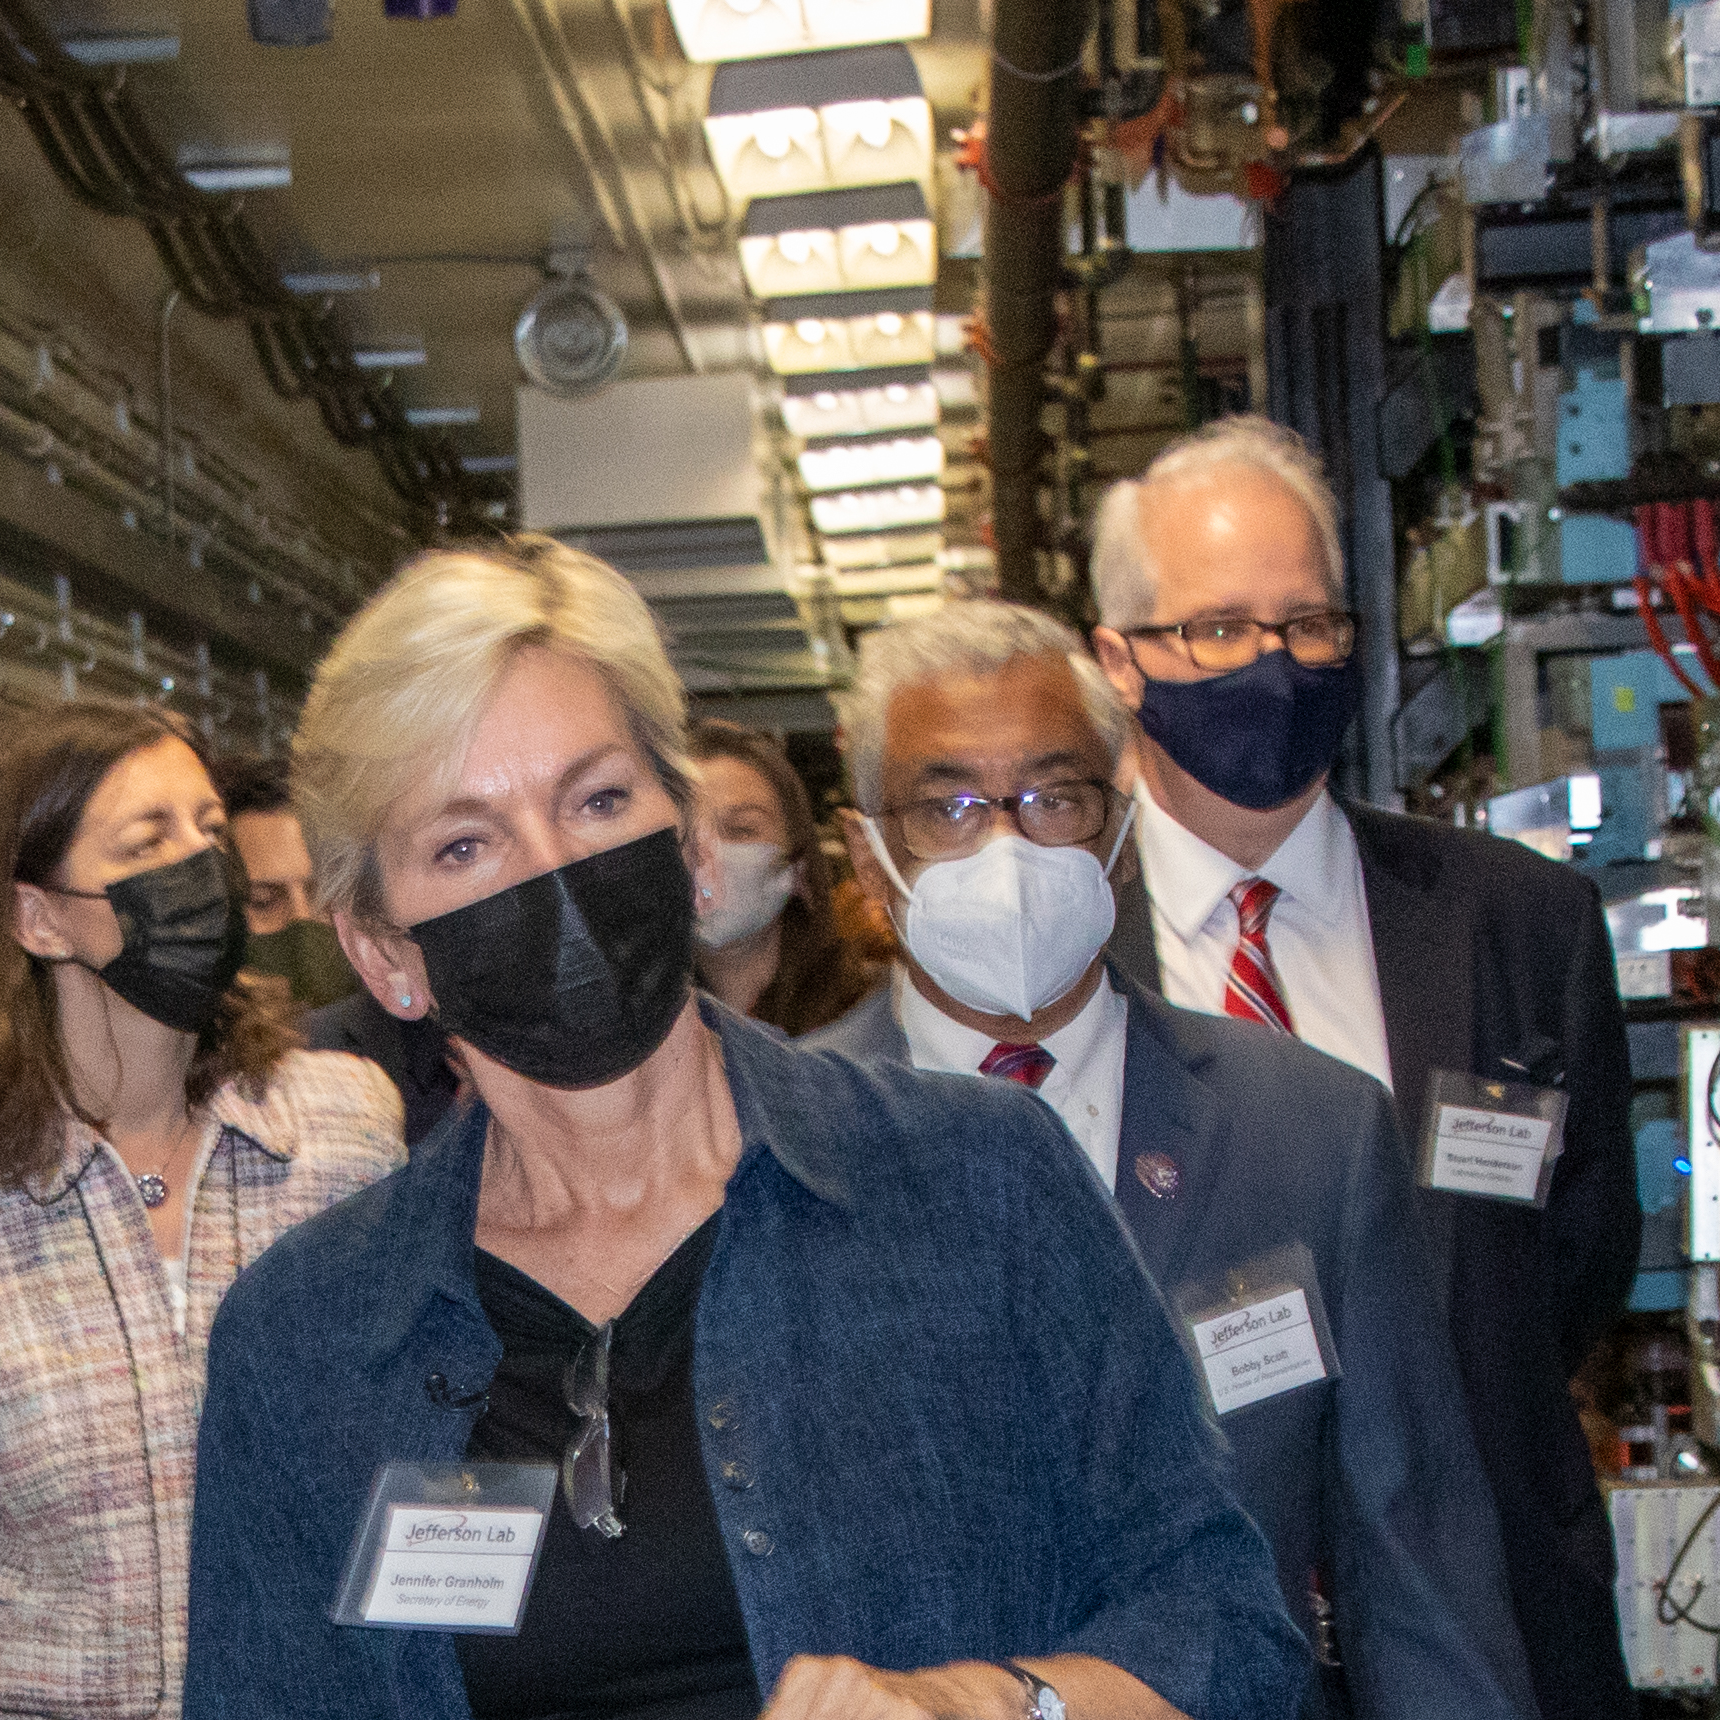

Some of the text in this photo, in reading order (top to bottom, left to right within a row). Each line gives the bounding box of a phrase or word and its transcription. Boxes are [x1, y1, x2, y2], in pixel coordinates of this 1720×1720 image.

[1452, 1118, 1532, 1139] Jefferson Lab
[1211, 1307, 1292, 1345] Jefferson Lab
[1232, 1361, 1261, 1377] Bobby
[405, 1523, 516, 1543] Jefferson Lab
[391, 1574, 504, 1590] Jennifer Granholm
[397, 1593, 490, 1609] Secretary of Energy
